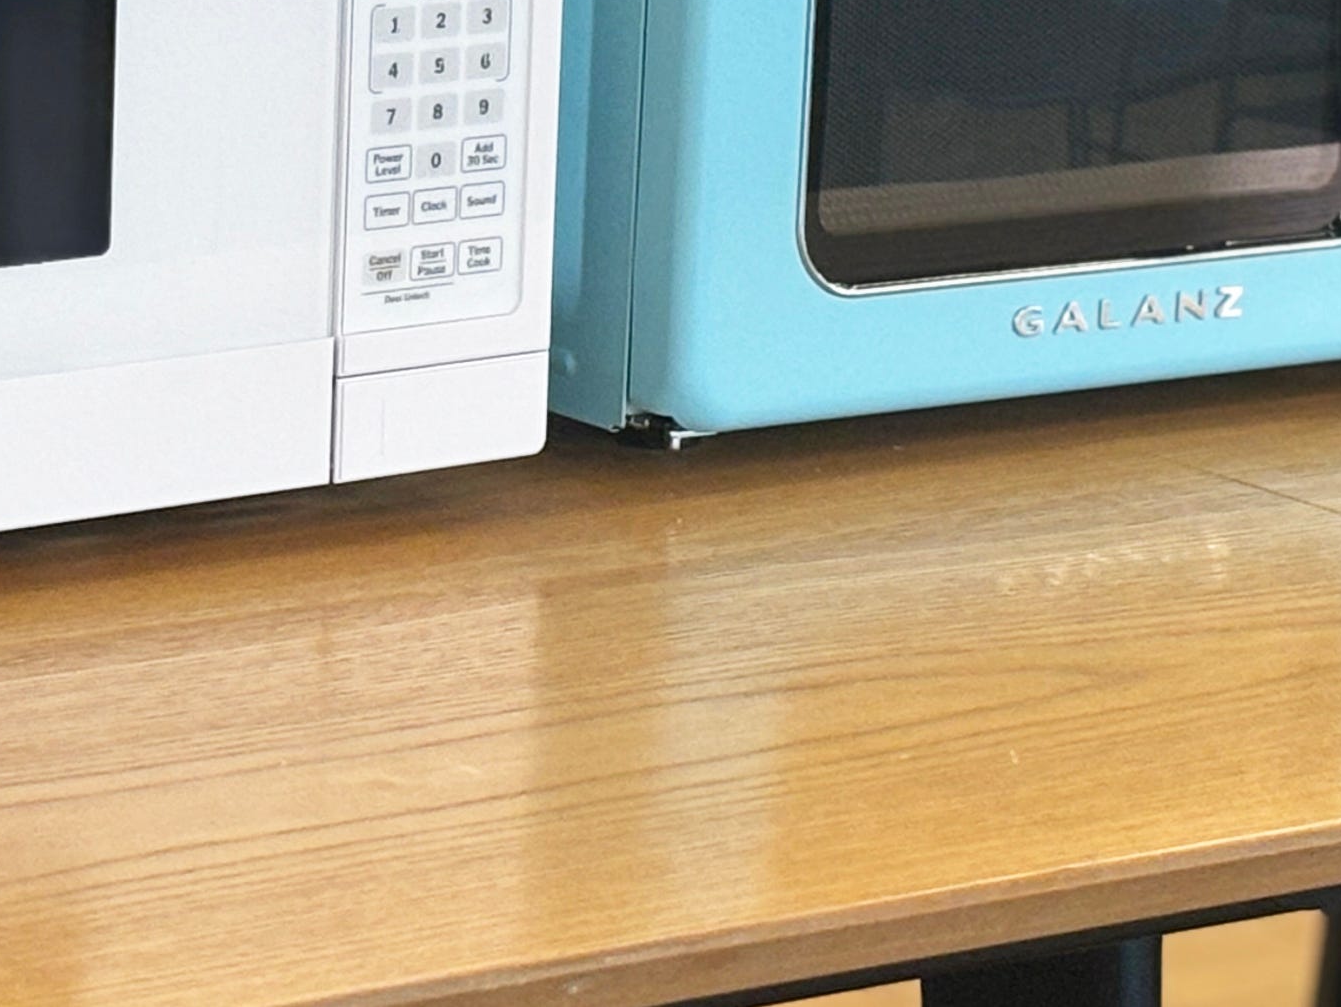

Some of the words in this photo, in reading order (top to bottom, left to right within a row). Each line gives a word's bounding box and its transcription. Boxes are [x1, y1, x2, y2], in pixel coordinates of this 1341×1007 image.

[436, 12, 446, 29] 2
[482, 8, 492, 24] 3
[391, 17, 398, 34] 1
[434, 58, 445, 74] 5
[480, 53, 490, 69] 6
[388, 62, 398, 78] 4
[433, 103, 443, 120] 8
[479, 99, 489, 115] 9
[386, 108, 396, 125] 7
[474, 141, 494, 153] Add
[373, 153, 403, 164] Power
[431, 152, 441, 169] 0
[467, 155, 480, 166] 30
[482, 154, 499, 164] Sec
[375, 165, 401, 176] Level
[421, 200, 447, 212] Clock
[467, 194, 497, 206] Sound
[373, 206, 401, 218] Timer
[420, 248, 445, 260] Start
[467, 245, 491, 256] Time
[369, 253, 402, 266] Cancel
[466, 257, 491, 268] Cook
[376, 270, 393, 282] Off
[417, 265, 446, 276] Pause
[1012, 285, 1244, 338] GALANZ
